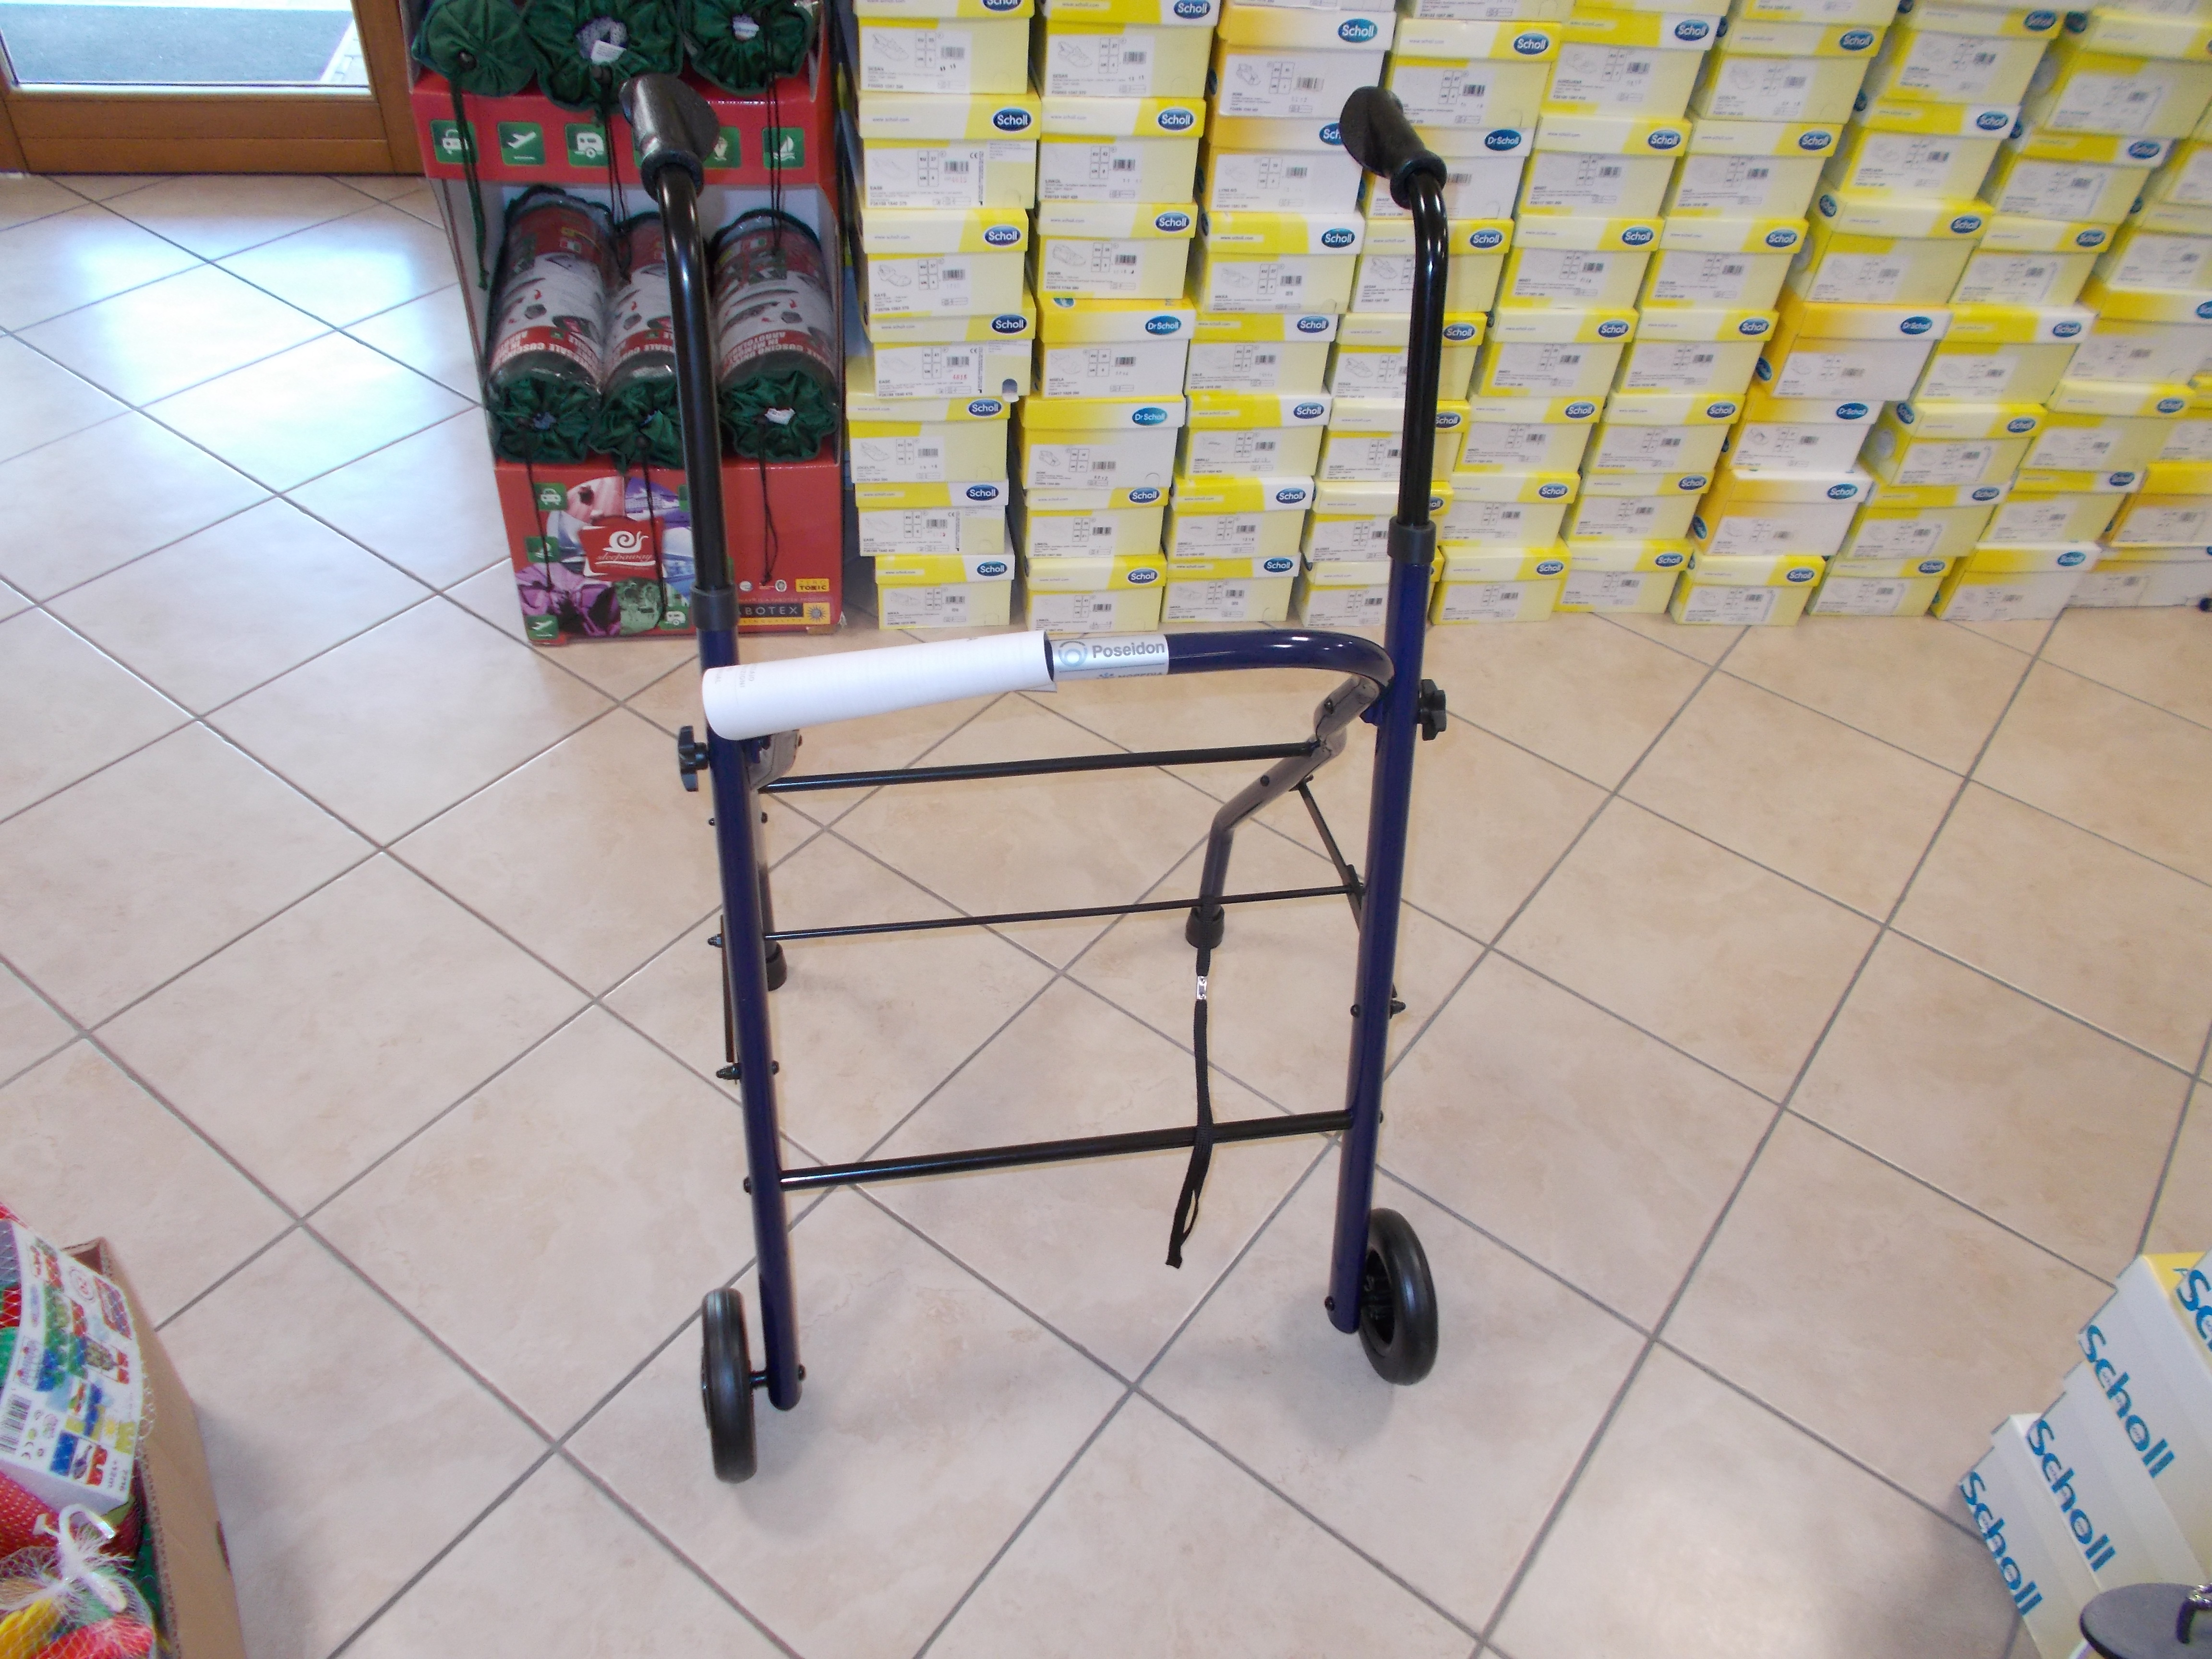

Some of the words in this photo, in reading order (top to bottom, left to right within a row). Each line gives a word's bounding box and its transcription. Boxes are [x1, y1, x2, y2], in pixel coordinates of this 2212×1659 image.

[1178, 2, 1207, 13] Scholl
[1342, 26, 1374, 37] Scholl
[1678, 24, 1707, 36] Scholl
[1517, 38, 1546, 49] Scholl
[1844, 35, 1871, 45] Scholl
[998, 115, 1028, 125] Scholl
[1162, 115, 1190, 125] Scholl
[1323, 129, 1340, 139] Sch
[1651, 135, 1679, 144] Scholl
[1802, 135, 1829, 145] Scholl
[1159, 217, 1186, 227] Scholl
[989, 231, 1017, 240] Scholl
[1325, 233, 1352, 242] Scholl
[1473, 234, 1500, 243] Scholl
[1625, 229, 1651, 240] Scholl
[1769, 234, 1795, 243] Scholl
[996, 320, 1023, 328] Scholl
[1300, 320, 1326, 328] Scholl
[1601, 325, 1626, 333] Scholl
[1742, 321, 1767, 331] Scholl
[1446, 327, 1472, 337] Scholl
[972, 404, 998, 412] Scholl
[1297, 406, 1322, 415] Scholl
[1568, 406, 1592, 414] Scholl
[1682, 478, 1704, 487] Scholl
[596, 553, 652, 562] sleepaway
[1092, 642, 1165, 659] Poseidon
[2176, 1269, 2212, 1352] Sc
[2079, 1324, 2176, 1479] Scholl
[2026, 1419, 2116, 1572] Scholl
[1960, 1471, 2043, 1615] Scholl
